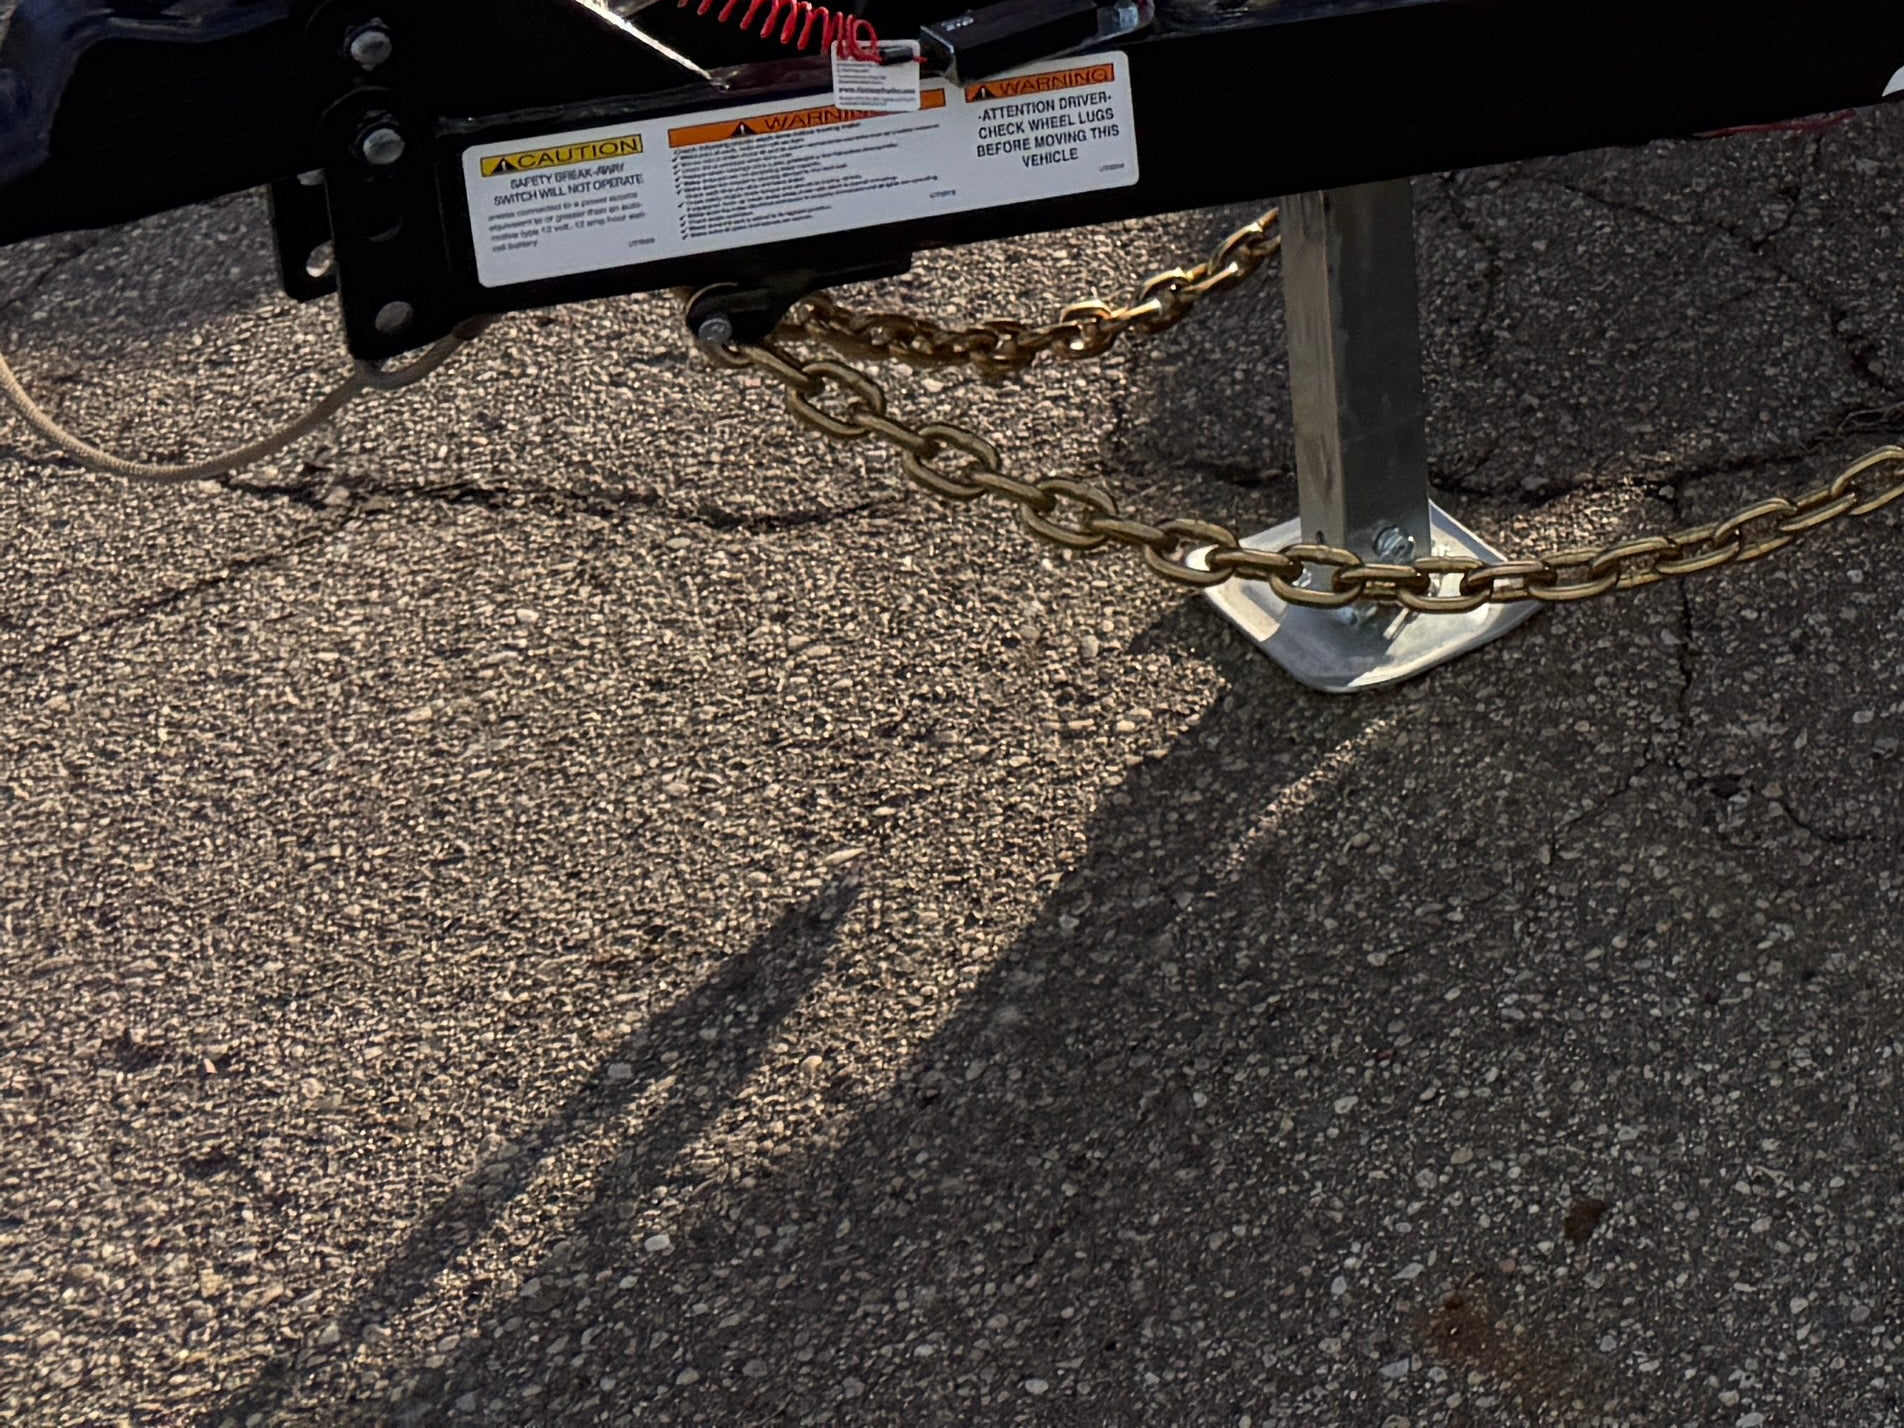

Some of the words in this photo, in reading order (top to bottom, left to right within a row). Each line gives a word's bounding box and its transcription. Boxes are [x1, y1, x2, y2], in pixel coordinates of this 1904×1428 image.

[1000, 69, 1108, 95] WARNING
[978, 123, 1024, 140] CHECK
[1028, 115, 1074, 131] WHEEL
[1078, 108, 1114, 124] LUGS
[517, 137, 639, 168] CAUTION
[977, 138, 1032, 158] BEFORE
[1034, 130, 1087, 148] MOVING
[1090, 124, 1120, 140] THIS
[1022, 148, 1079, 168] VEHICLE
[494, 190, 537, 206] SWITCH
[540, 187, 566, 201] WILL
[568, 182, 591, 195] NOT
[593, 174, 644, 193] OPERATE
[511, 174, 552, 190] SAFETY
